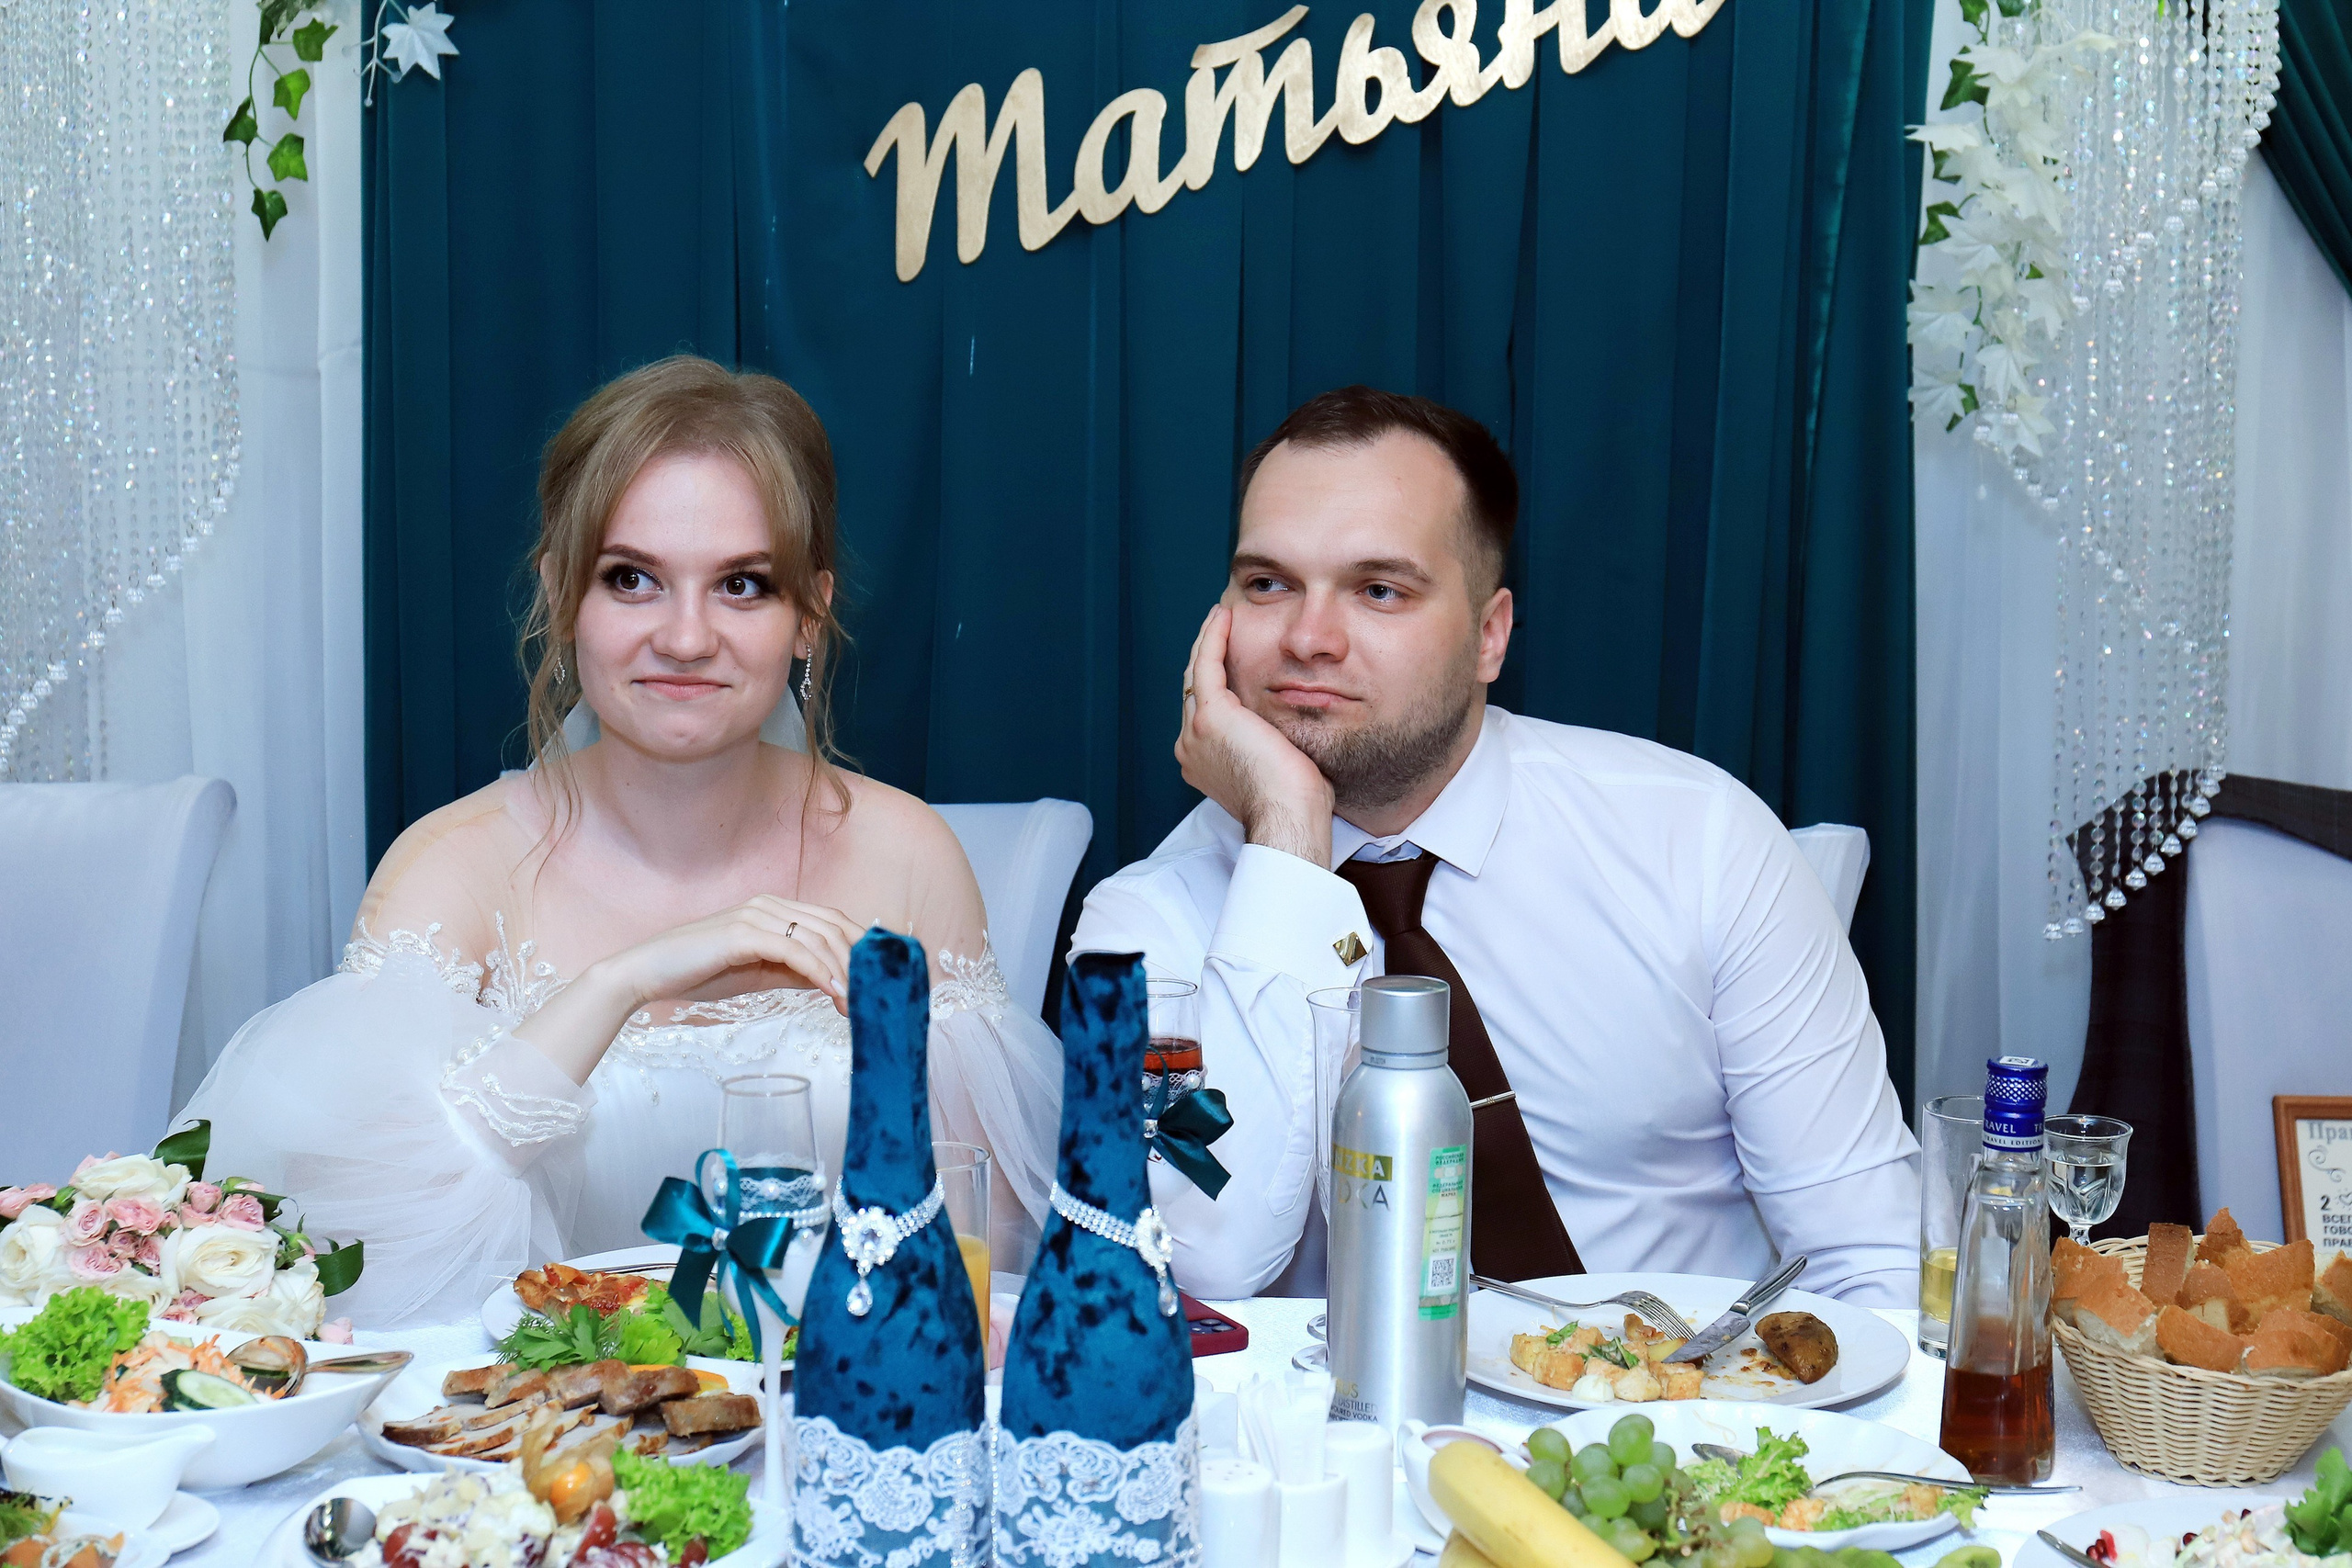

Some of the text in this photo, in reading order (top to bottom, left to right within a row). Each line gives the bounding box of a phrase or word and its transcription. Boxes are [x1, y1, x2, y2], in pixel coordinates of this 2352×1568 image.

[2307, 1120, 2352, 1145] Пра
[2320, 1195, 2331, 1211] 2
[1352, 1412, 1378, 1423] VODKA
